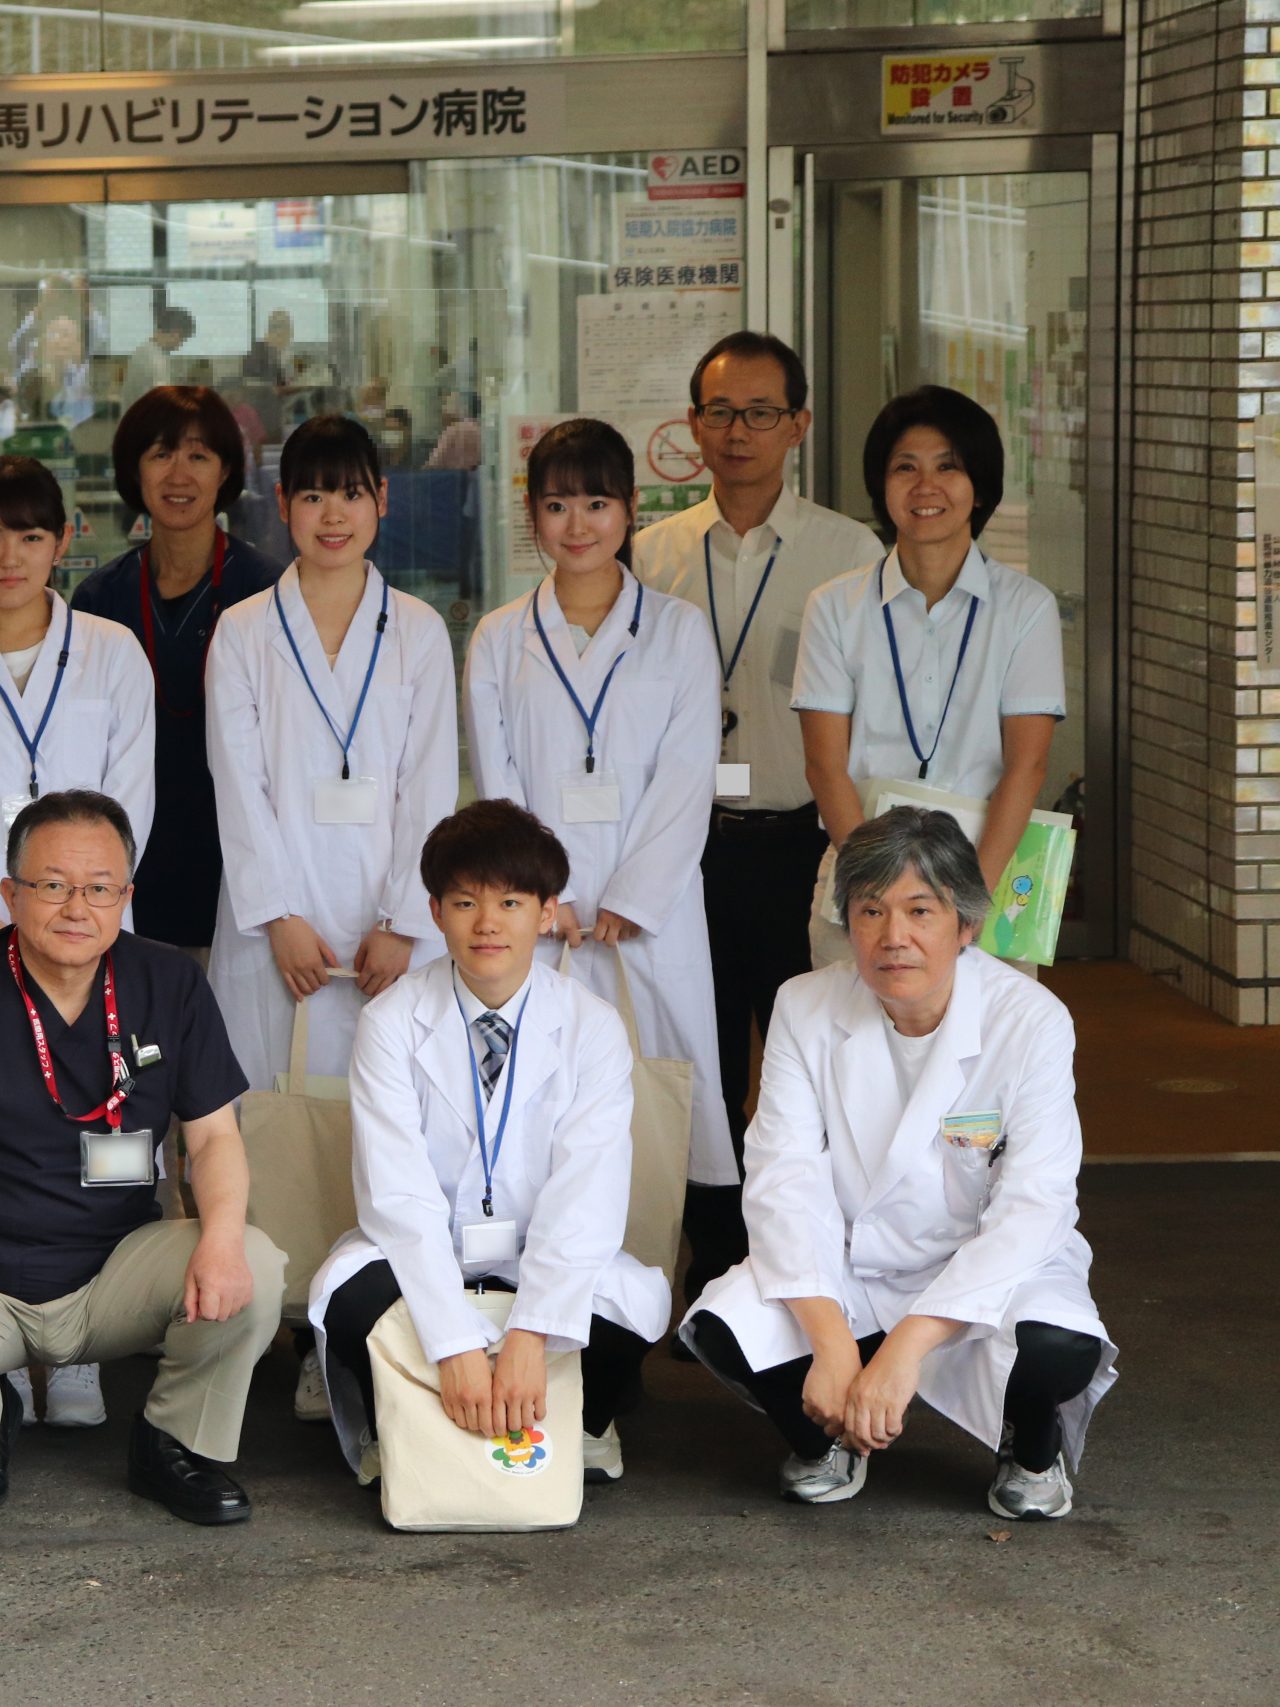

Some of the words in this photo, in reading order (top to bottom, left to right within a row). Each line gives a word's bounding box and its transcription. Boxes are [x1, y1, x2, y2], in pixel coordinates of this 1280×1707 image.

[891, 61, 991, 85] 防犯カメラ
[679, 155, 741, 177] AED
[614, 264, 740, 287] 保険医療機関
